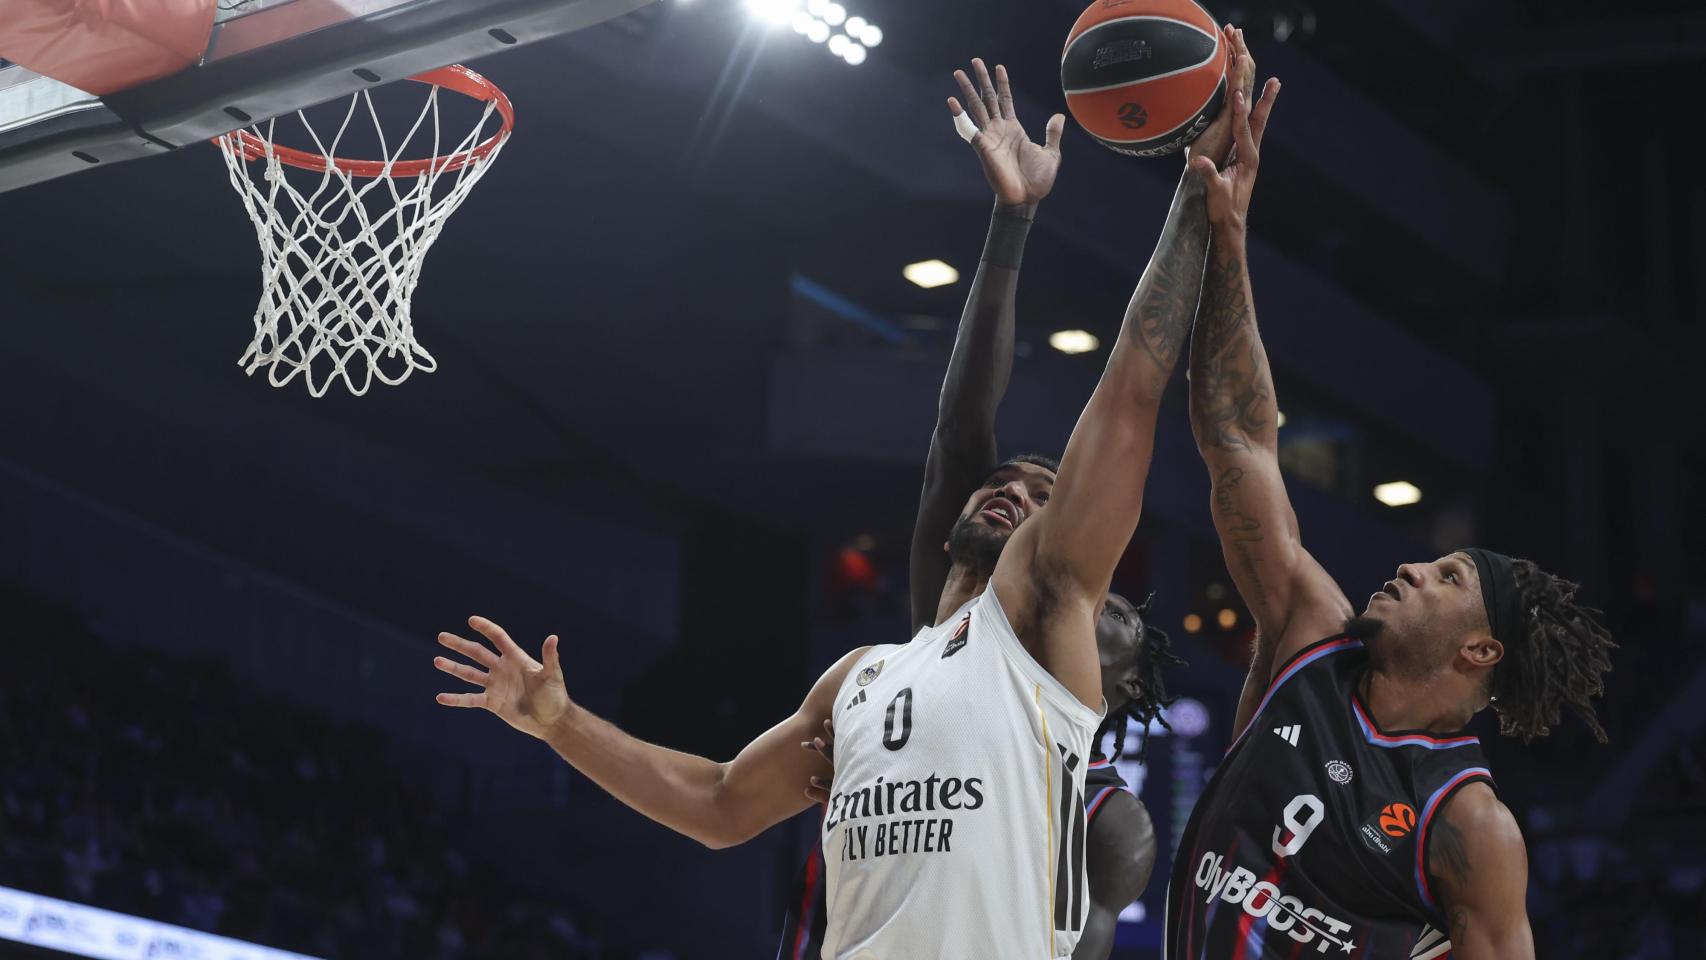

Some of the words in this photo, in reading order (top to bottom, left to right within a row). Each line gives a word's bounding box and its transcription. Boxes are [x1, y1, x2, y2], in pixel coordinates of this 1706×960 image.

[883, 687, 913, 751] 0
[826, 771, 984, 833] Emirates
[1272, 794, 1325, 858] 9
[875, 818, 953, 857] BETTER
[1195, 851, 1352, 954] OlyBOOST
